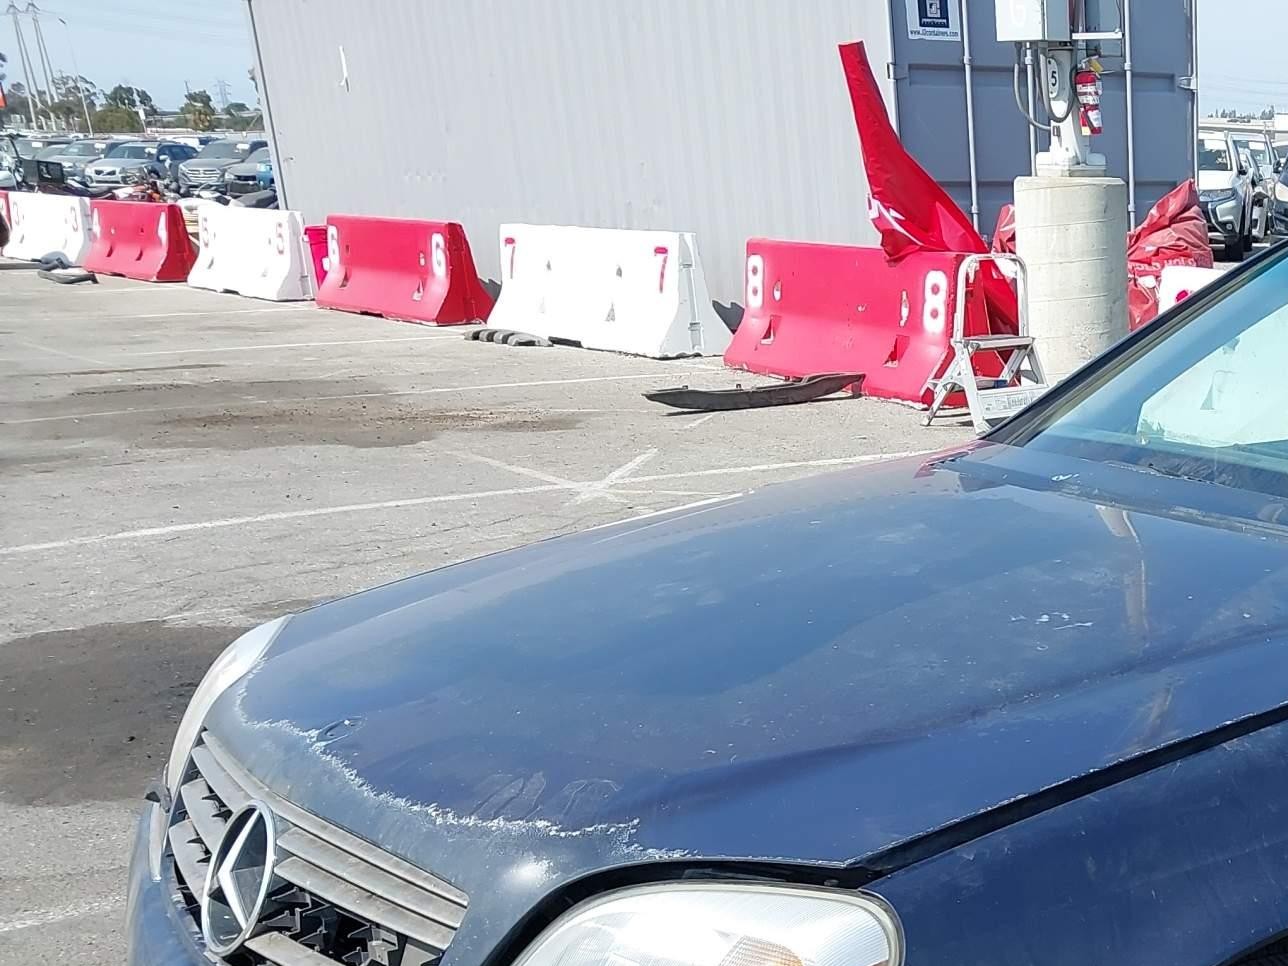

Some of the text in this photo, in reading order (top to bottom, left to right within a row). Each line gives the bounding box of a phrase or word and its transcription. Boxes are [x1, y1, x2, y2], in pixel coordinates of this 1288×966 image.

[70, 207, 78, 232] 3
[275, 222, 285, 255] 5
[431, 232, 446, 279] 6
[504, 237, 516, 280] 7
[653, 246, 669, 294] 7
[746, 254, 765, 310] 8
[923, 270, 948, 334] 8
